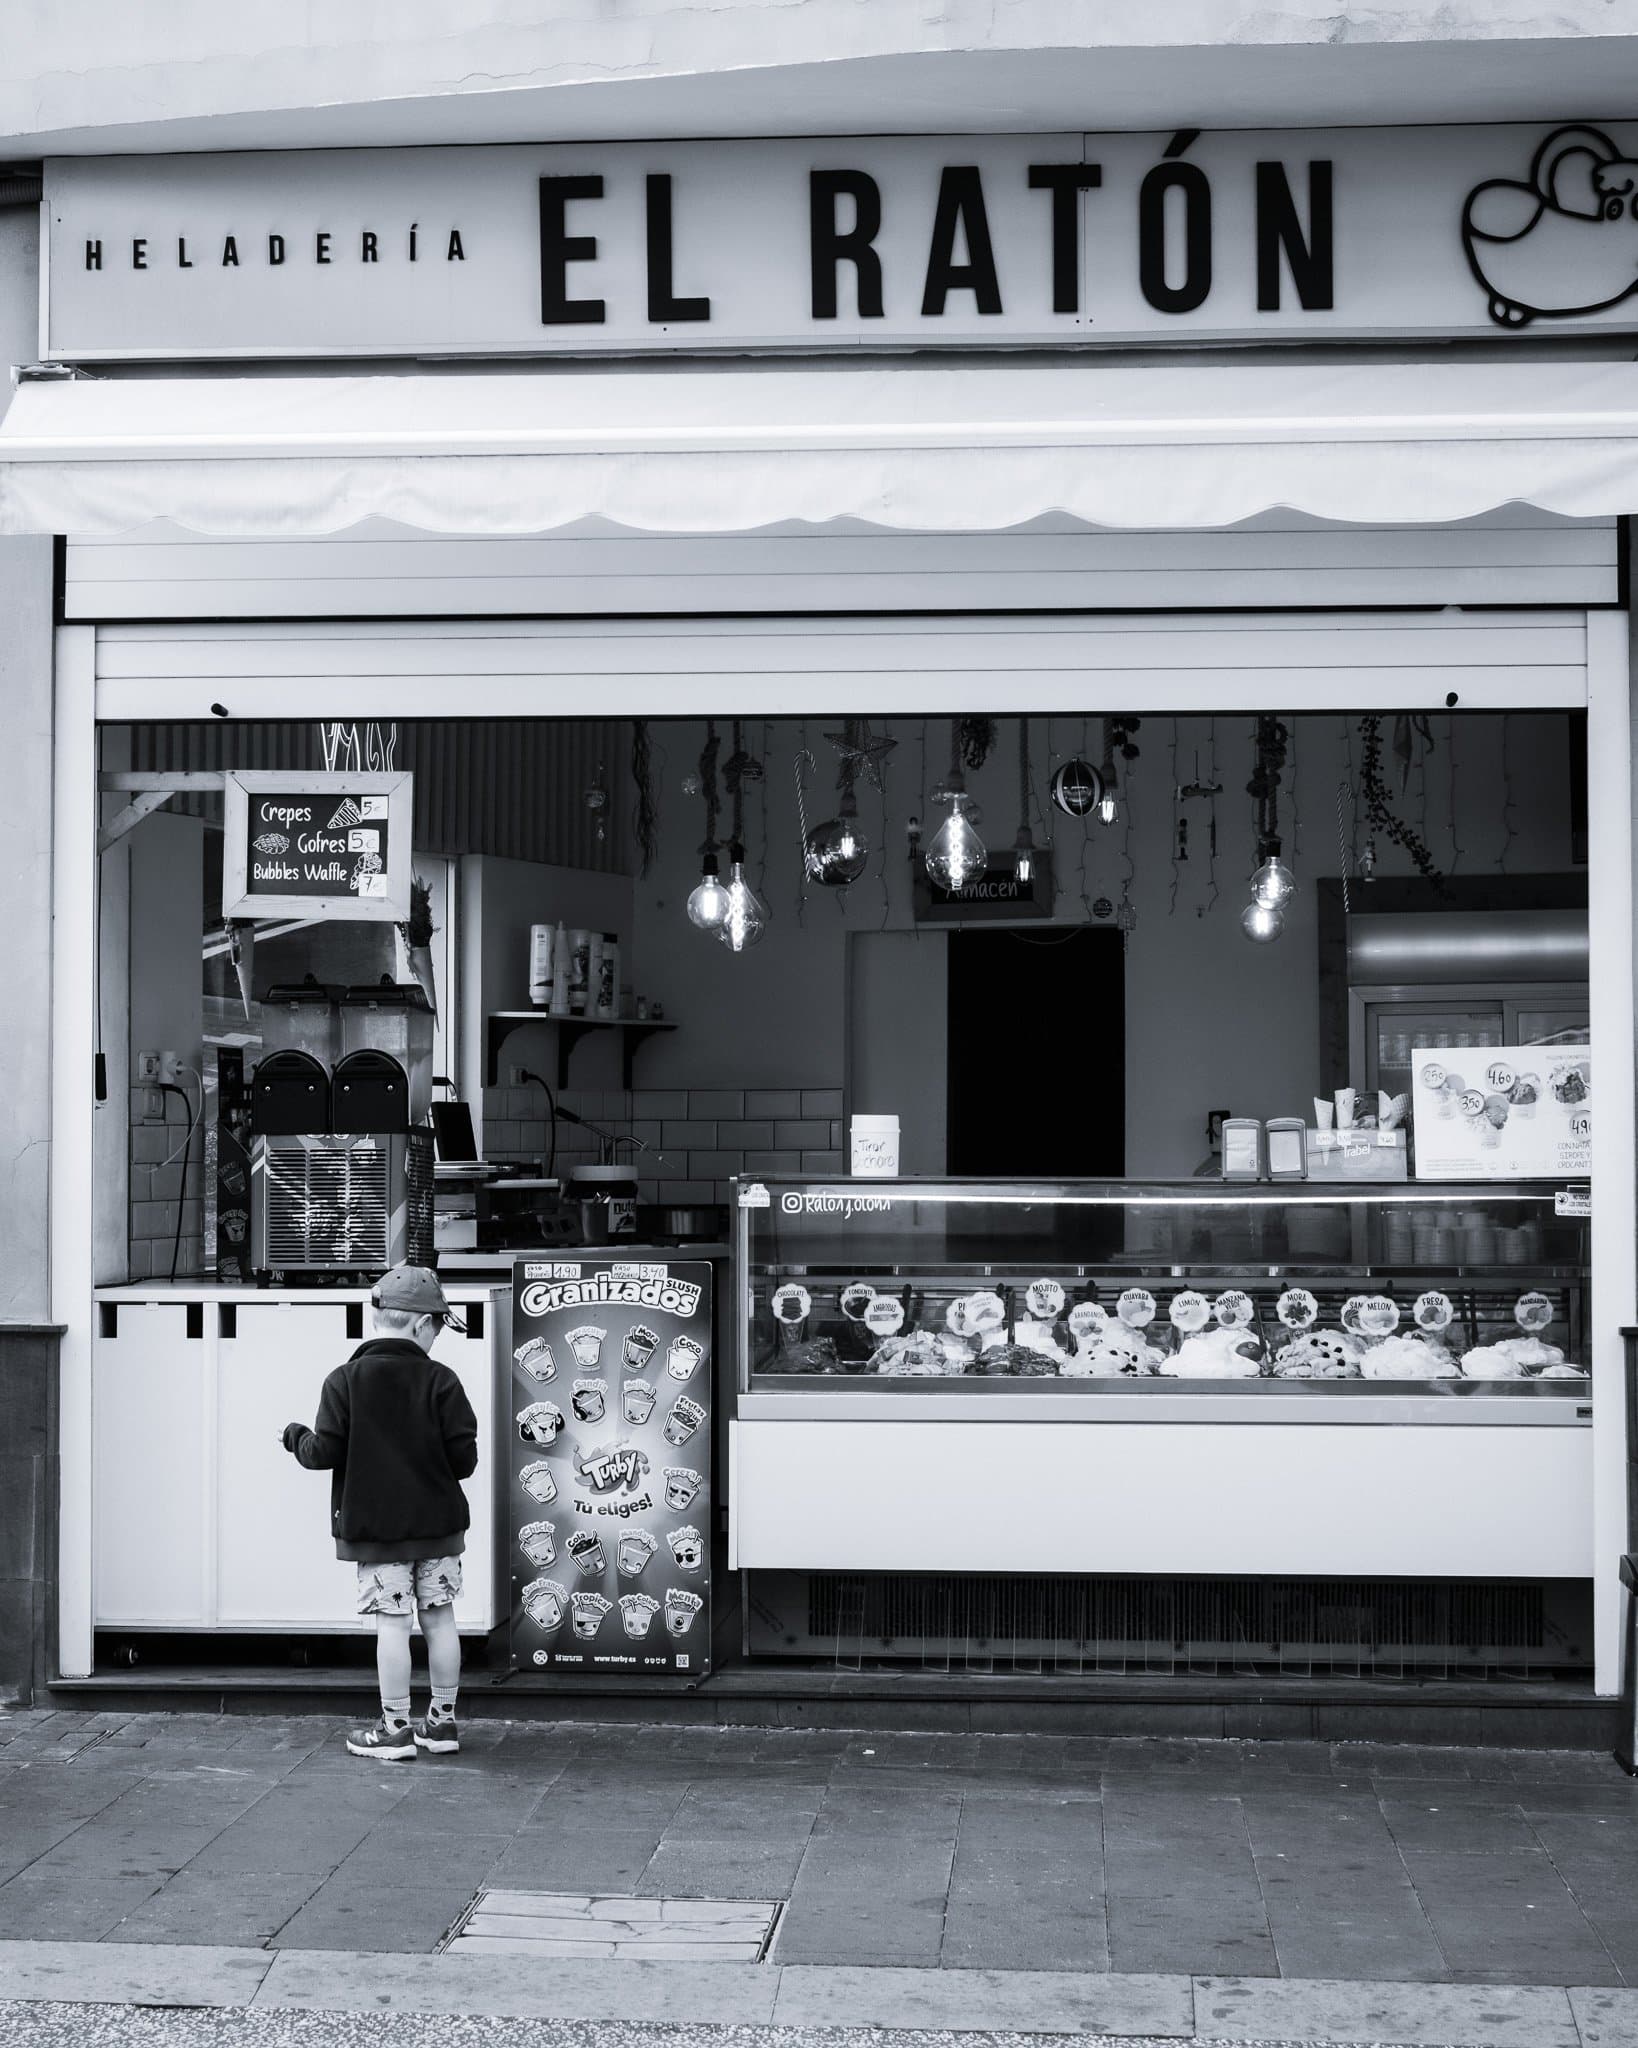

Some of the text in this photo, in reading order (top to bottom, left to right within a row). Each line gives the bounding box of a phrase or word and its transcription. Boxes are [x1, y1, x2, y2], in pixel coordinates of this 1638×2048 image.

[86, 129, 1335, 325] HELADERÍA EL RATÓN
[260, 802, 312, 830] Crepes
[297, 830, 346, 853] Gofres
[253, 861, 299, 880] Bubbles
[304, 861, 348, 881] Waffle
[523, 1273, 696, 1316] Granizados
[665, 1279, 699, 1297] SLUSH
[1032, 1284, 1059, 1294] MOJITO
[1217, 1293, 1246, 1306] MANZANA
[1286, 1293, 1307, 1302] MORA
[1422, 1296, 1444, 1307] FRESA
[637, 1327, 659, 1344] Mora
[679, 1337, 701, 1354] Coco
[574, 1493, 653, 1518] Tú eliges!
[521, 1523, 555, 1539] Chicle
[567, 1532, 586, 1548] Cola
[573, 1593, 612, 1610] Tropical
